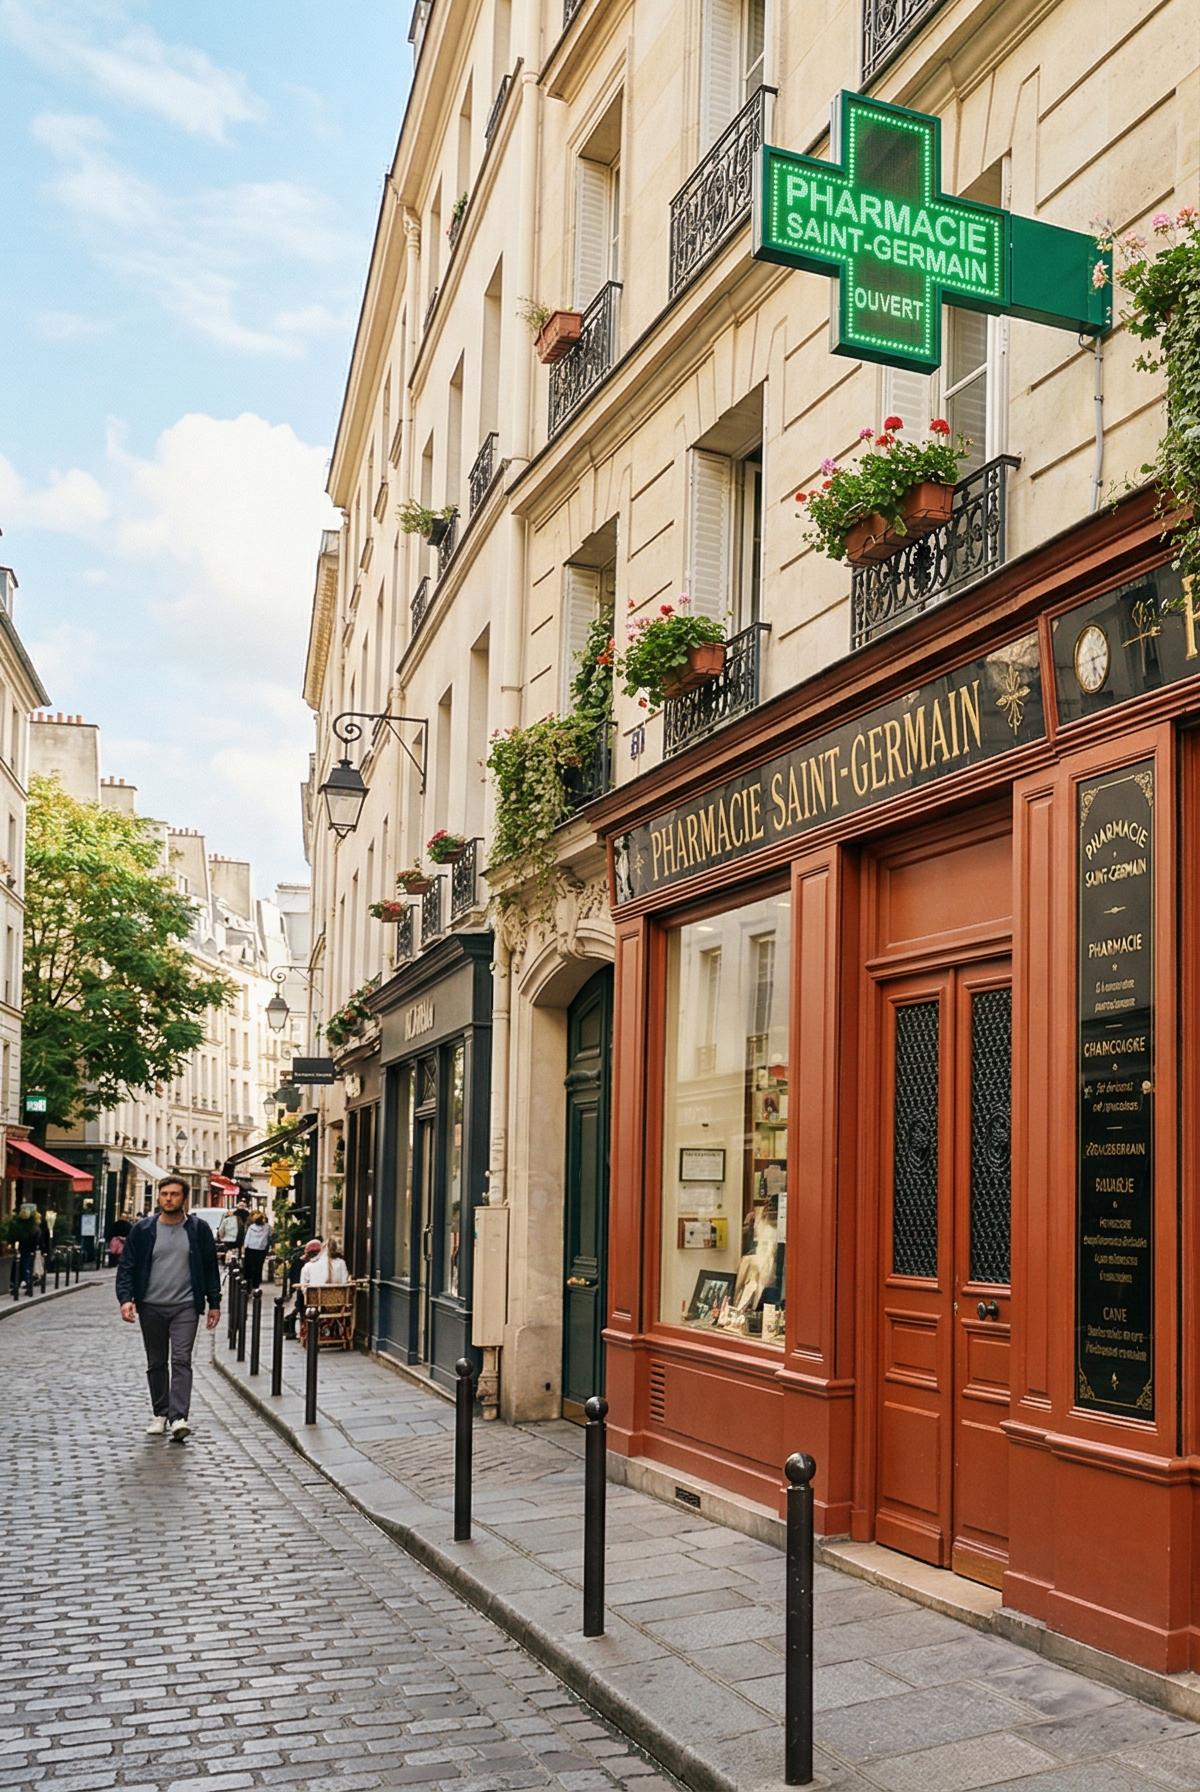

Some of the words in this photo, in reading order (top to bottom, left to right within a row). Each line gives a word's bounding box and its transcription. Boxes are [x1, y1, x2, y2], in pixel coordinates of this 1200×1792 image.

[786, 175, 987, 255] PHARMACIE
[786, 212, 987, 284] SAINT-GERMAIN
[855, 286, 924, 321] OUVERT
[651, 783, 765, 881] PHARMACIE
[770, 679, 982, 832] SAINT-GERMAIN
[1088, 933, 1142, 959] PHARMACIE
